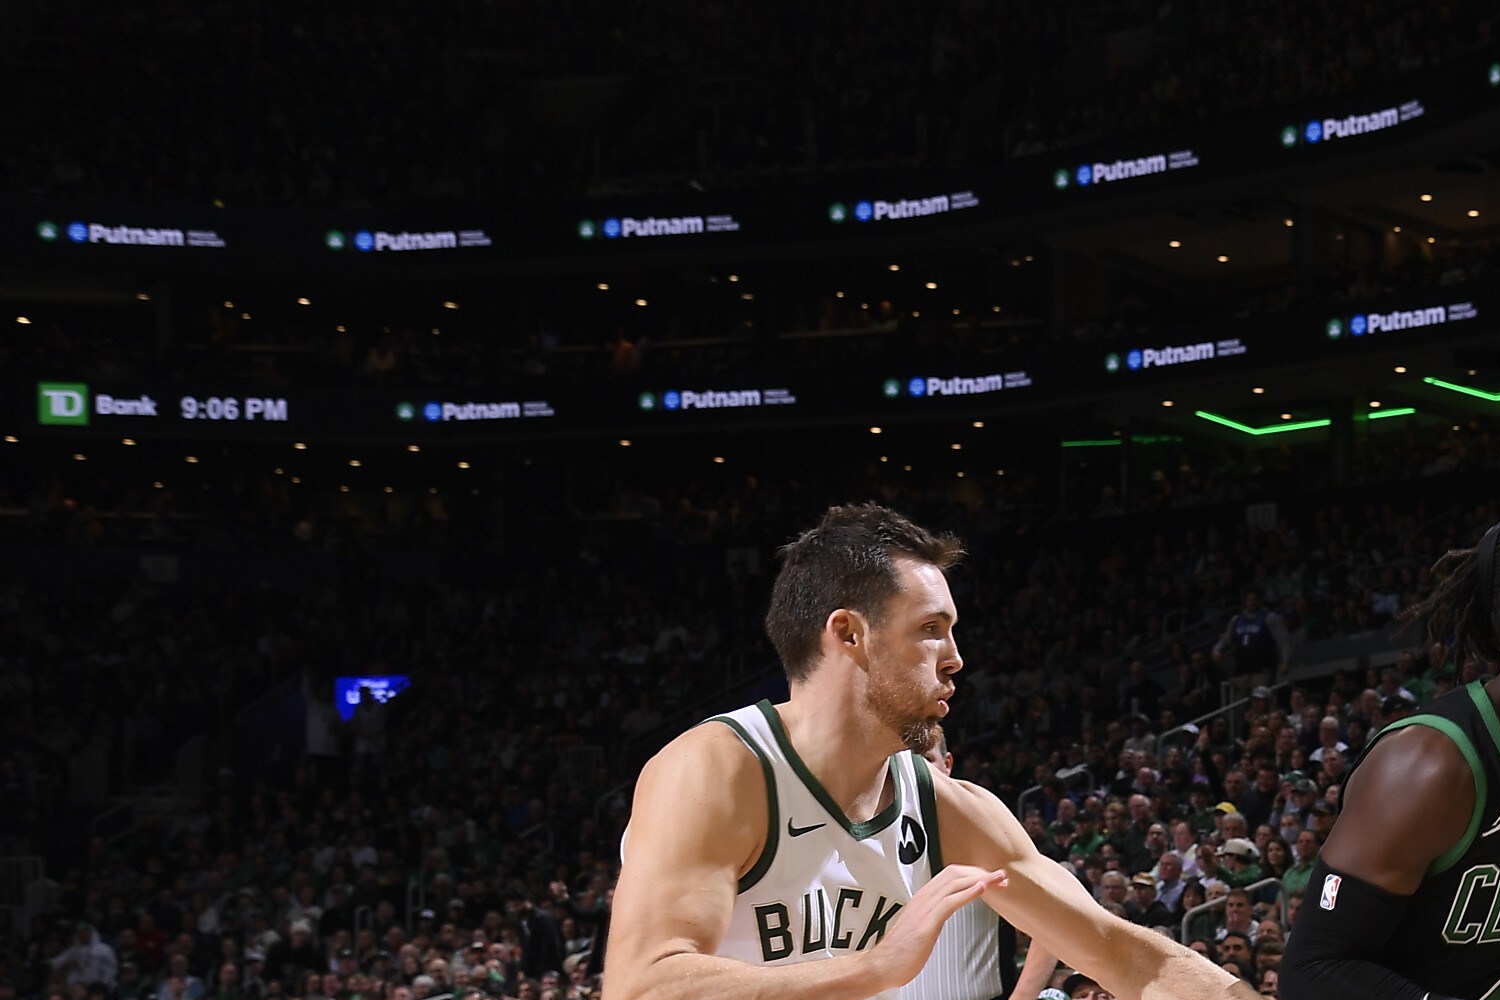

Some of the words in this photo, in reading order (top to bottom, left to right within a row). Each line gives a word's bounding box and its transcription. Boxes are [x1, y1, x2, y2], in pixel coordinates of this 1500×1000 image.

[1322, 108, 1399, 141] Putnam
[1092, 154, 1167, 184] Putnam
[873, 195, 949, 221] Putnam
[88, 223, 184, 246] Putnam
[621, 216, 704, 238] Putnam
[374, 231, 457, 251] Putnam
[1367, 306, 1446, 334] Putnam
[1142, 342, 1215, 368] Putnam
[926, 374, 1003, 396] Putnam
[95, 394, 157, 416] Bank
[181, 397, 241, 420] 9:06
[246, 398, 287, 421] PM
[681, 389, 761, 410] Putnam
[442, 402, 521, 421] Putnam
[751, 886, 905, 964] BUCK
